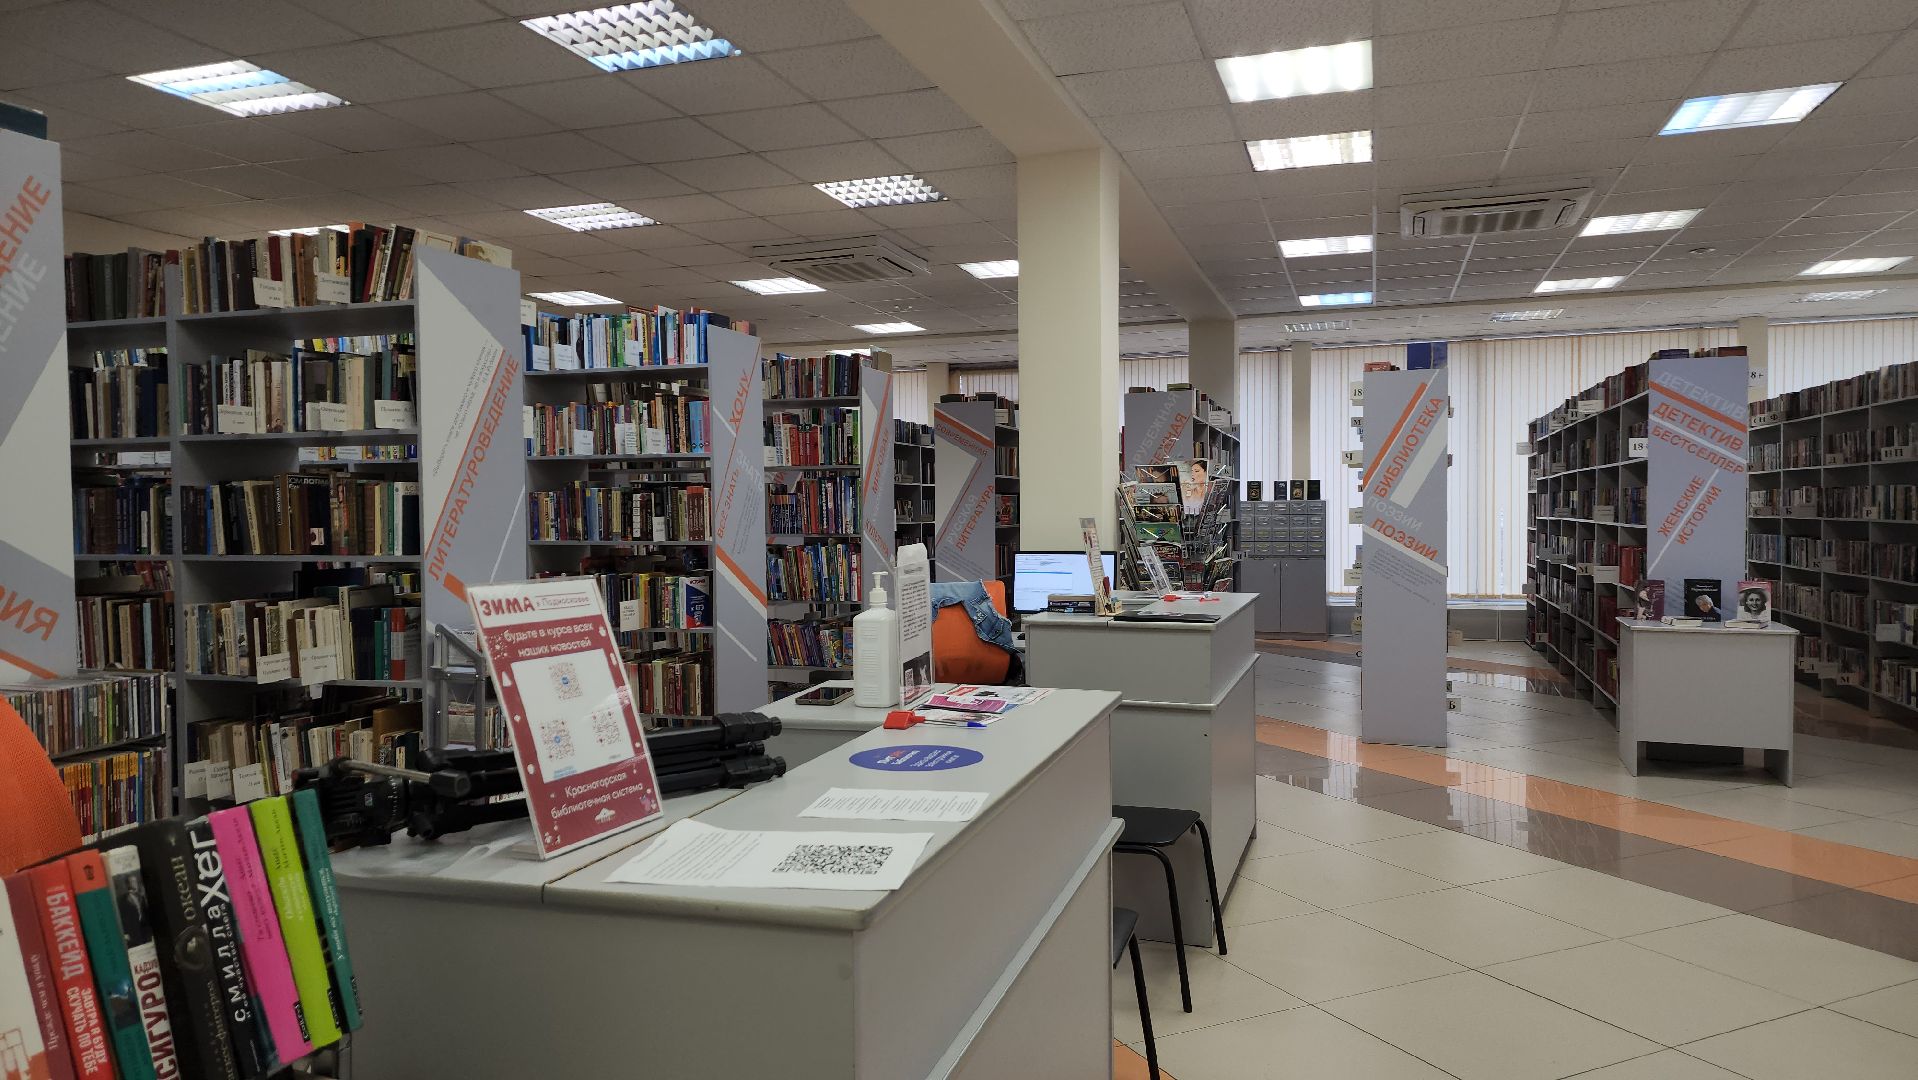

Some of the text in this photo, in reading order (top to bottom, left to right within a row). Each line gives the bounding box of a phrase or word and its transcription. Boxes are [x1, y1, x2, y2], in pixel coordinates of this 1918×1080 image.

[0, 175, 51, 288] ЕНИЕ
[729, 369, 750, 427] ХОЧУ
[1655, 370, 1747, 421] ДЕТЕКТИВ
[935, 423, 988, 457] СОВРЕМЕННАЯ
[1125, 390, 1181, 480] РУБЕЖНАЯ
[1373, 396, 1445, 500] БИБЛИОТЕКА
[1651, 424, 1745, 476] БЕСТСЕЛЛЕР
[1652, 401, 1744, 453] ДЕТЕКТИВ
[428, 354, 519, 582] ЛИТЕРАТУРОВЕДЕНИЕ
[955, 484, 995, 552] ЛИТЕРАТУРА
[1366, 496, 1425, 532] ПОЭЗИИ
[1657, 474, 1705, 539] ЖЕНСКИЕ
[1677, 484, 1722, 546] ИСТОРИИ
[1370, 517, 1438, 562] ПОЭЗИИ
[0, 584, 60, 641] ИЯ
[480, 596, 535, 617] ЗИМА
[503, 630, 537, 644] будьте
[547, 625, 572, 639] курсе
[574, 621, 594, 633] всех
[518, 637, 592, 658] наших новостей
[551, 783, 644, 819] библиотечная система
[564, 771, 628, 799] Красногорская
[172, 855, 197, 920] океан
[65, 986, 98, 1076] СКУЧАТЬ ПО ТЕБЕ
[80, 987, 98, 1026] ЗАВТРА
[91, 1035, 108, 1066] БУДУ
[137, 970, 180, 1080] СИГУРО
